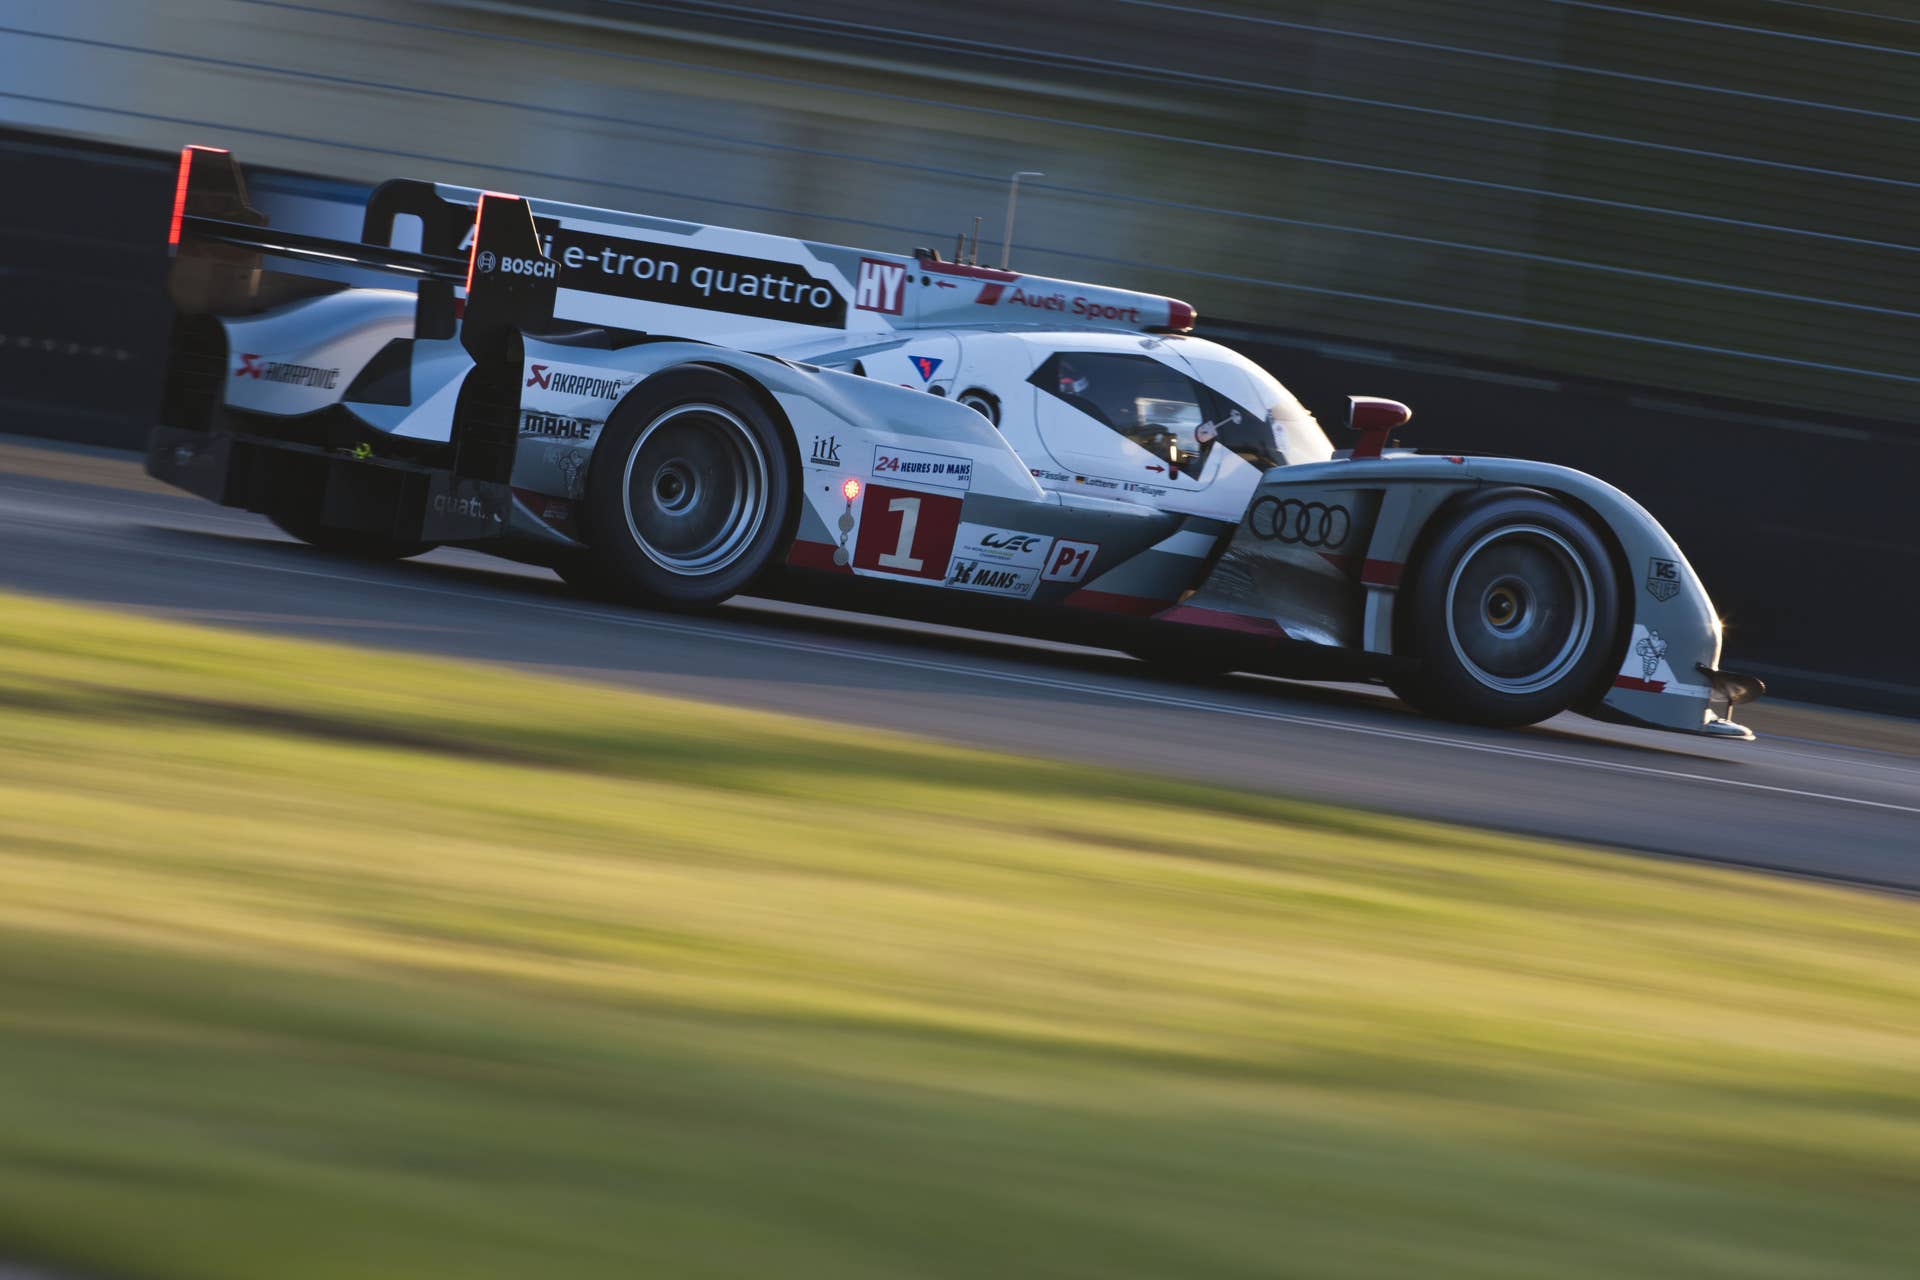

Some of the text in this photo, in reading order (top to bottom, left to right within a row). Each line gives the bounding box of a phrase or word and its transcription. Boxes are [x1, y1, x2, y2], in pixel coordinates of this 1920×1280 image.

[500, 256, 556, 279] BOSCH
[563, 245, 679, 284] e-tron
[690, 265, 833, 308] quattro
[858, 260, 904, 311] HY
[1008, 287, 1140, 324] Audi Sport
[524, 414, 592, 440] MAHLE
[811, 435, 842, 461] itk
[875, 456, 971, 475] 24 HEURES DU MANS
[878, 496, 924, 572] 1
[980, 532, 1041, 553] WEC
[1050, 546, 1090, 577] P1
